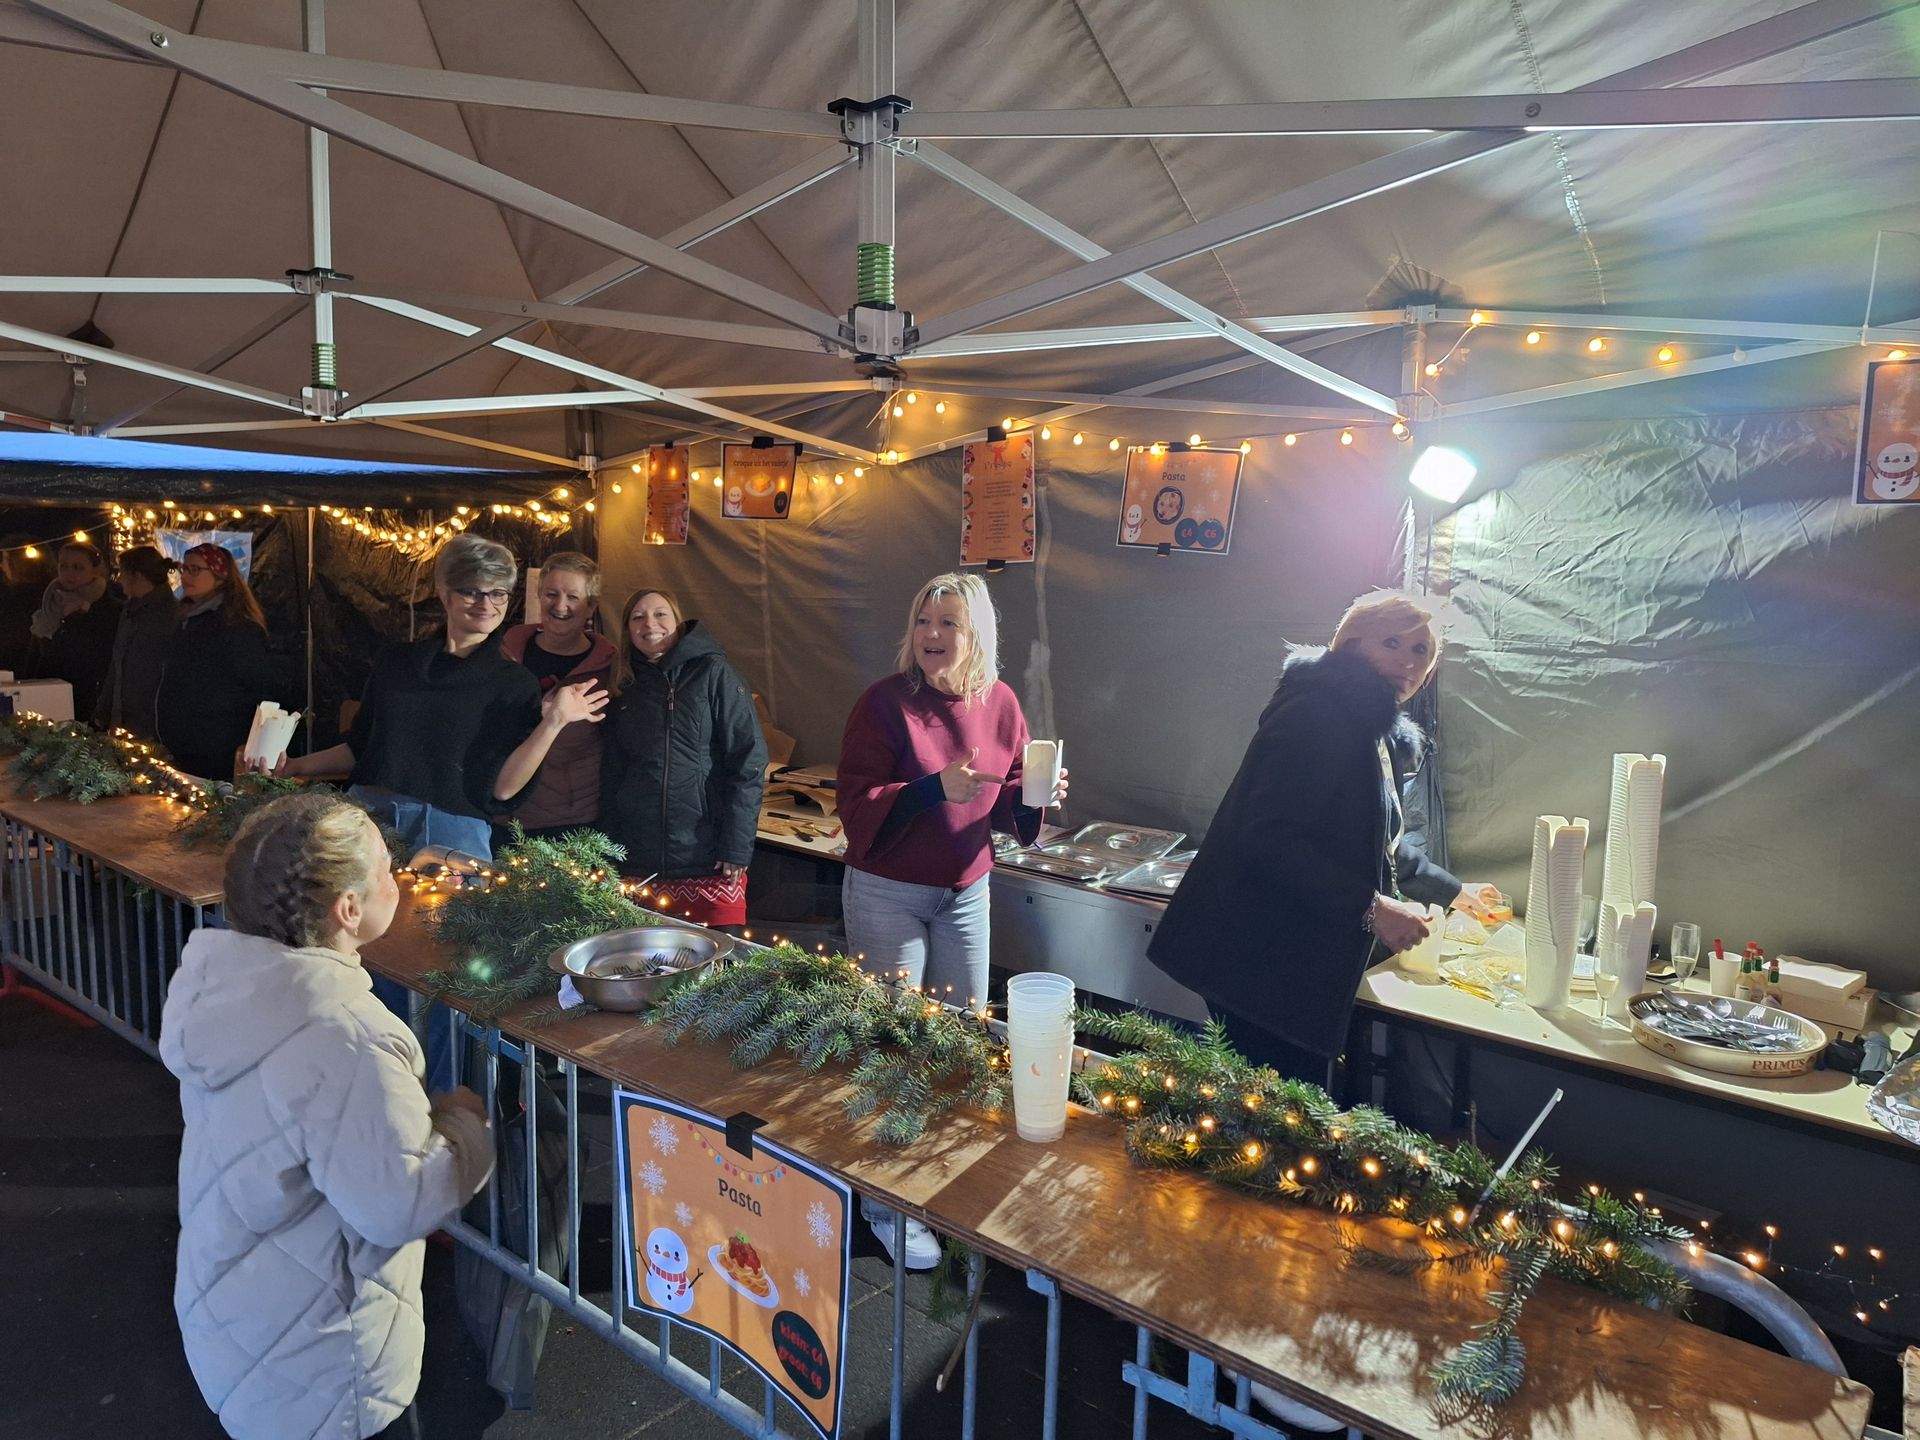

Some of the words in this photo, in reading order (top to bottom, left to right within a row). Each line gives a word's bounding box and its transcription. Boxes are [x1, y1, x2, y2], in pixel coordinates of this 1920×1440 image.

[1162, 471, 1186, 481] Pasta
[1752, 1058, 1806, 1071] PRIMUS
[717, 1177, 763, 1218] Pasta
